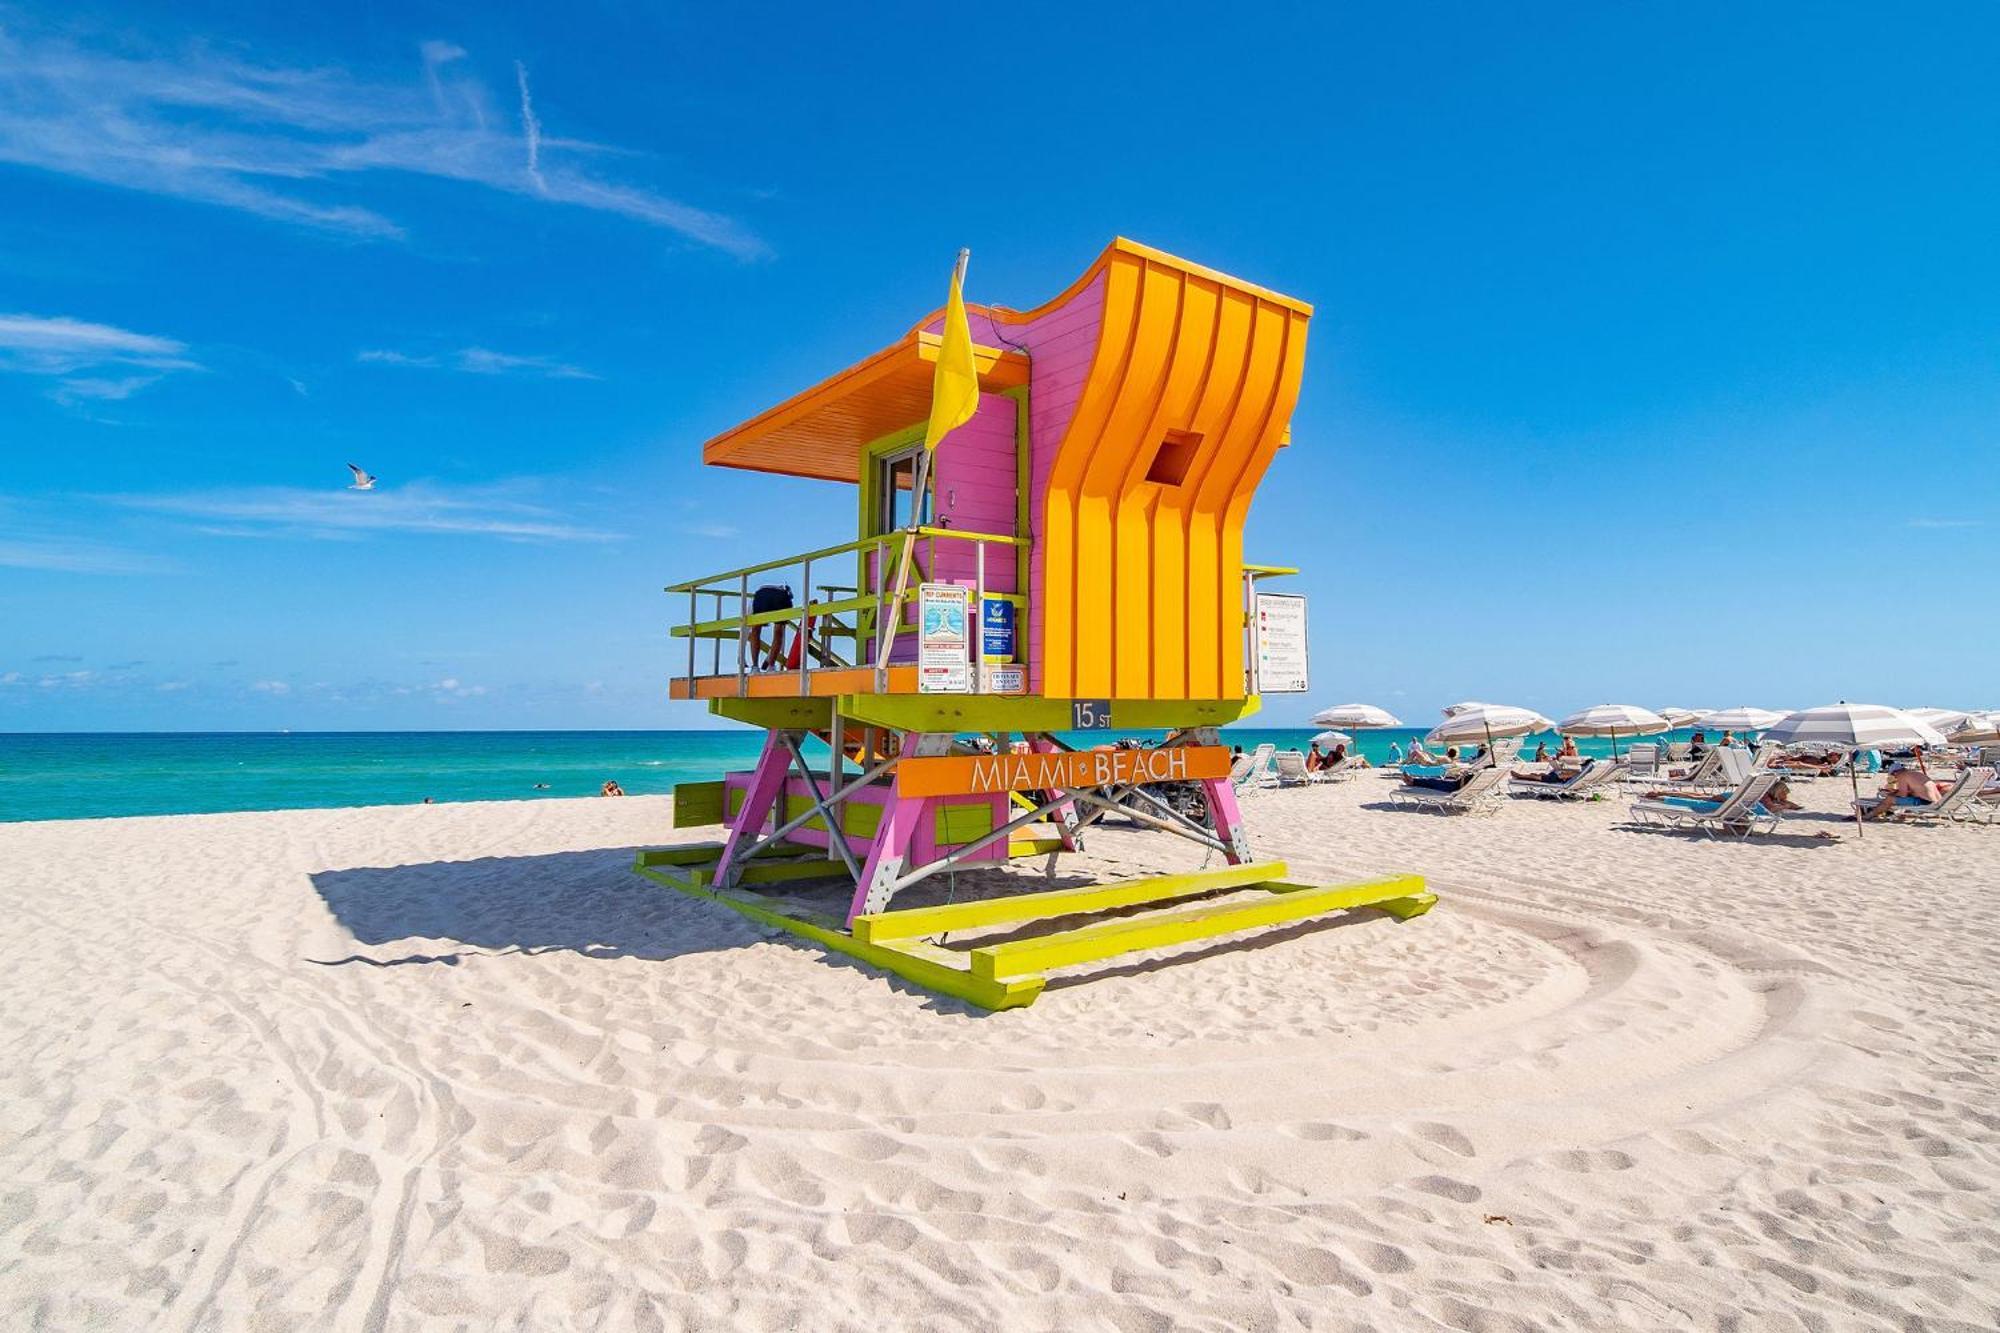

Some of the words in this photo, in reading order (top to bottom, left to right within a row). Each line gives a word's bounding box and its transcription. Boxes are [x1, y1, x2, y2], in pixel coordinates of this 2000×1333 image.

[1074, 703, 1094, 728] 15
[1099, 714, 1112, 728] ST
[971, 756, 1073, 793] MIAMI
[1095, 749, 1187, 785] BEACH
